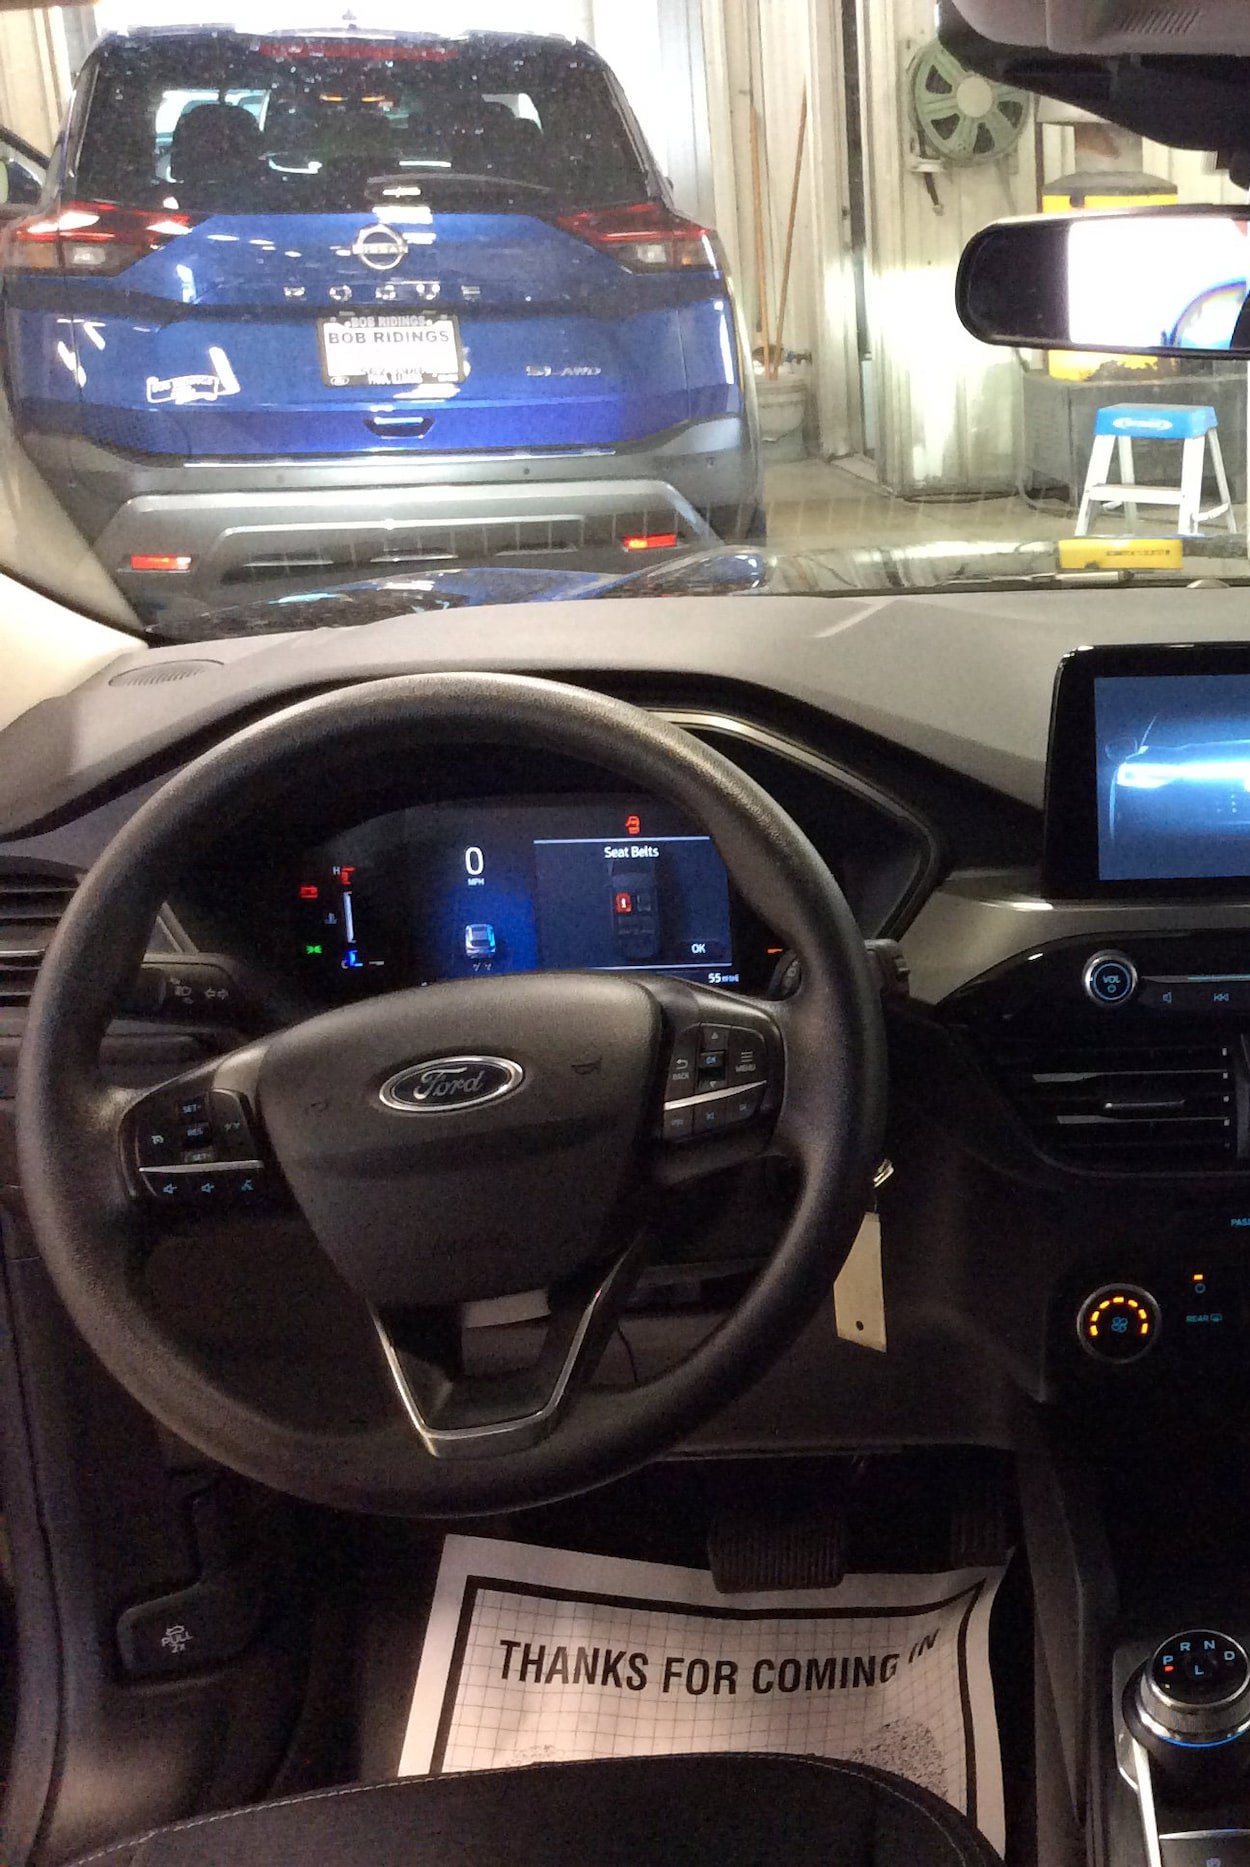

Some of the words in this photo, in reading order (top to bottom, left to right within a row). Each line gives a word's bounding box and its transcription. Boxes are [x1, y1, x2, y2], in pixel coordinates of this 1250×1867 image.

[351, 316, 376, 328] BOB
[378, 315, 426, 327] RIDINGS
[328, 332, 367, 344] BOB
[374, 331, 450, 343] RIDINGS
[604, 846, 630, 858] Seat
[631, 845, 660, 858] Belts
[465, 846, 484, 875] 0
[333, 866, 341, 875] H
[691, 943, 706, 954] OK
[708, 973, 721, 983] 55
[1103, 975, 1120, 983] VOL
[735, 1064, 756, 1072] MENU
[673, 1073, 690, 1081] BACK
[413, 1067, 485, 1100] Ford
[1186, 1315, 1209, 1323] REAR
[1180, 1641, 1191, 1651] R
[1203, 1640, 1216, 1650] N
[1162, 1655, 1174, 1665] P
[1224, 1651, 1236, 1661] D
[500, 1640, 649, 1692] THANKS
[662, 1657, 737, 1696] FOR
[752, 1653, 901, 1695] COMING
[908, 1627, 940, 1665] IN
[1194, 1664, 1204, 1676] L
